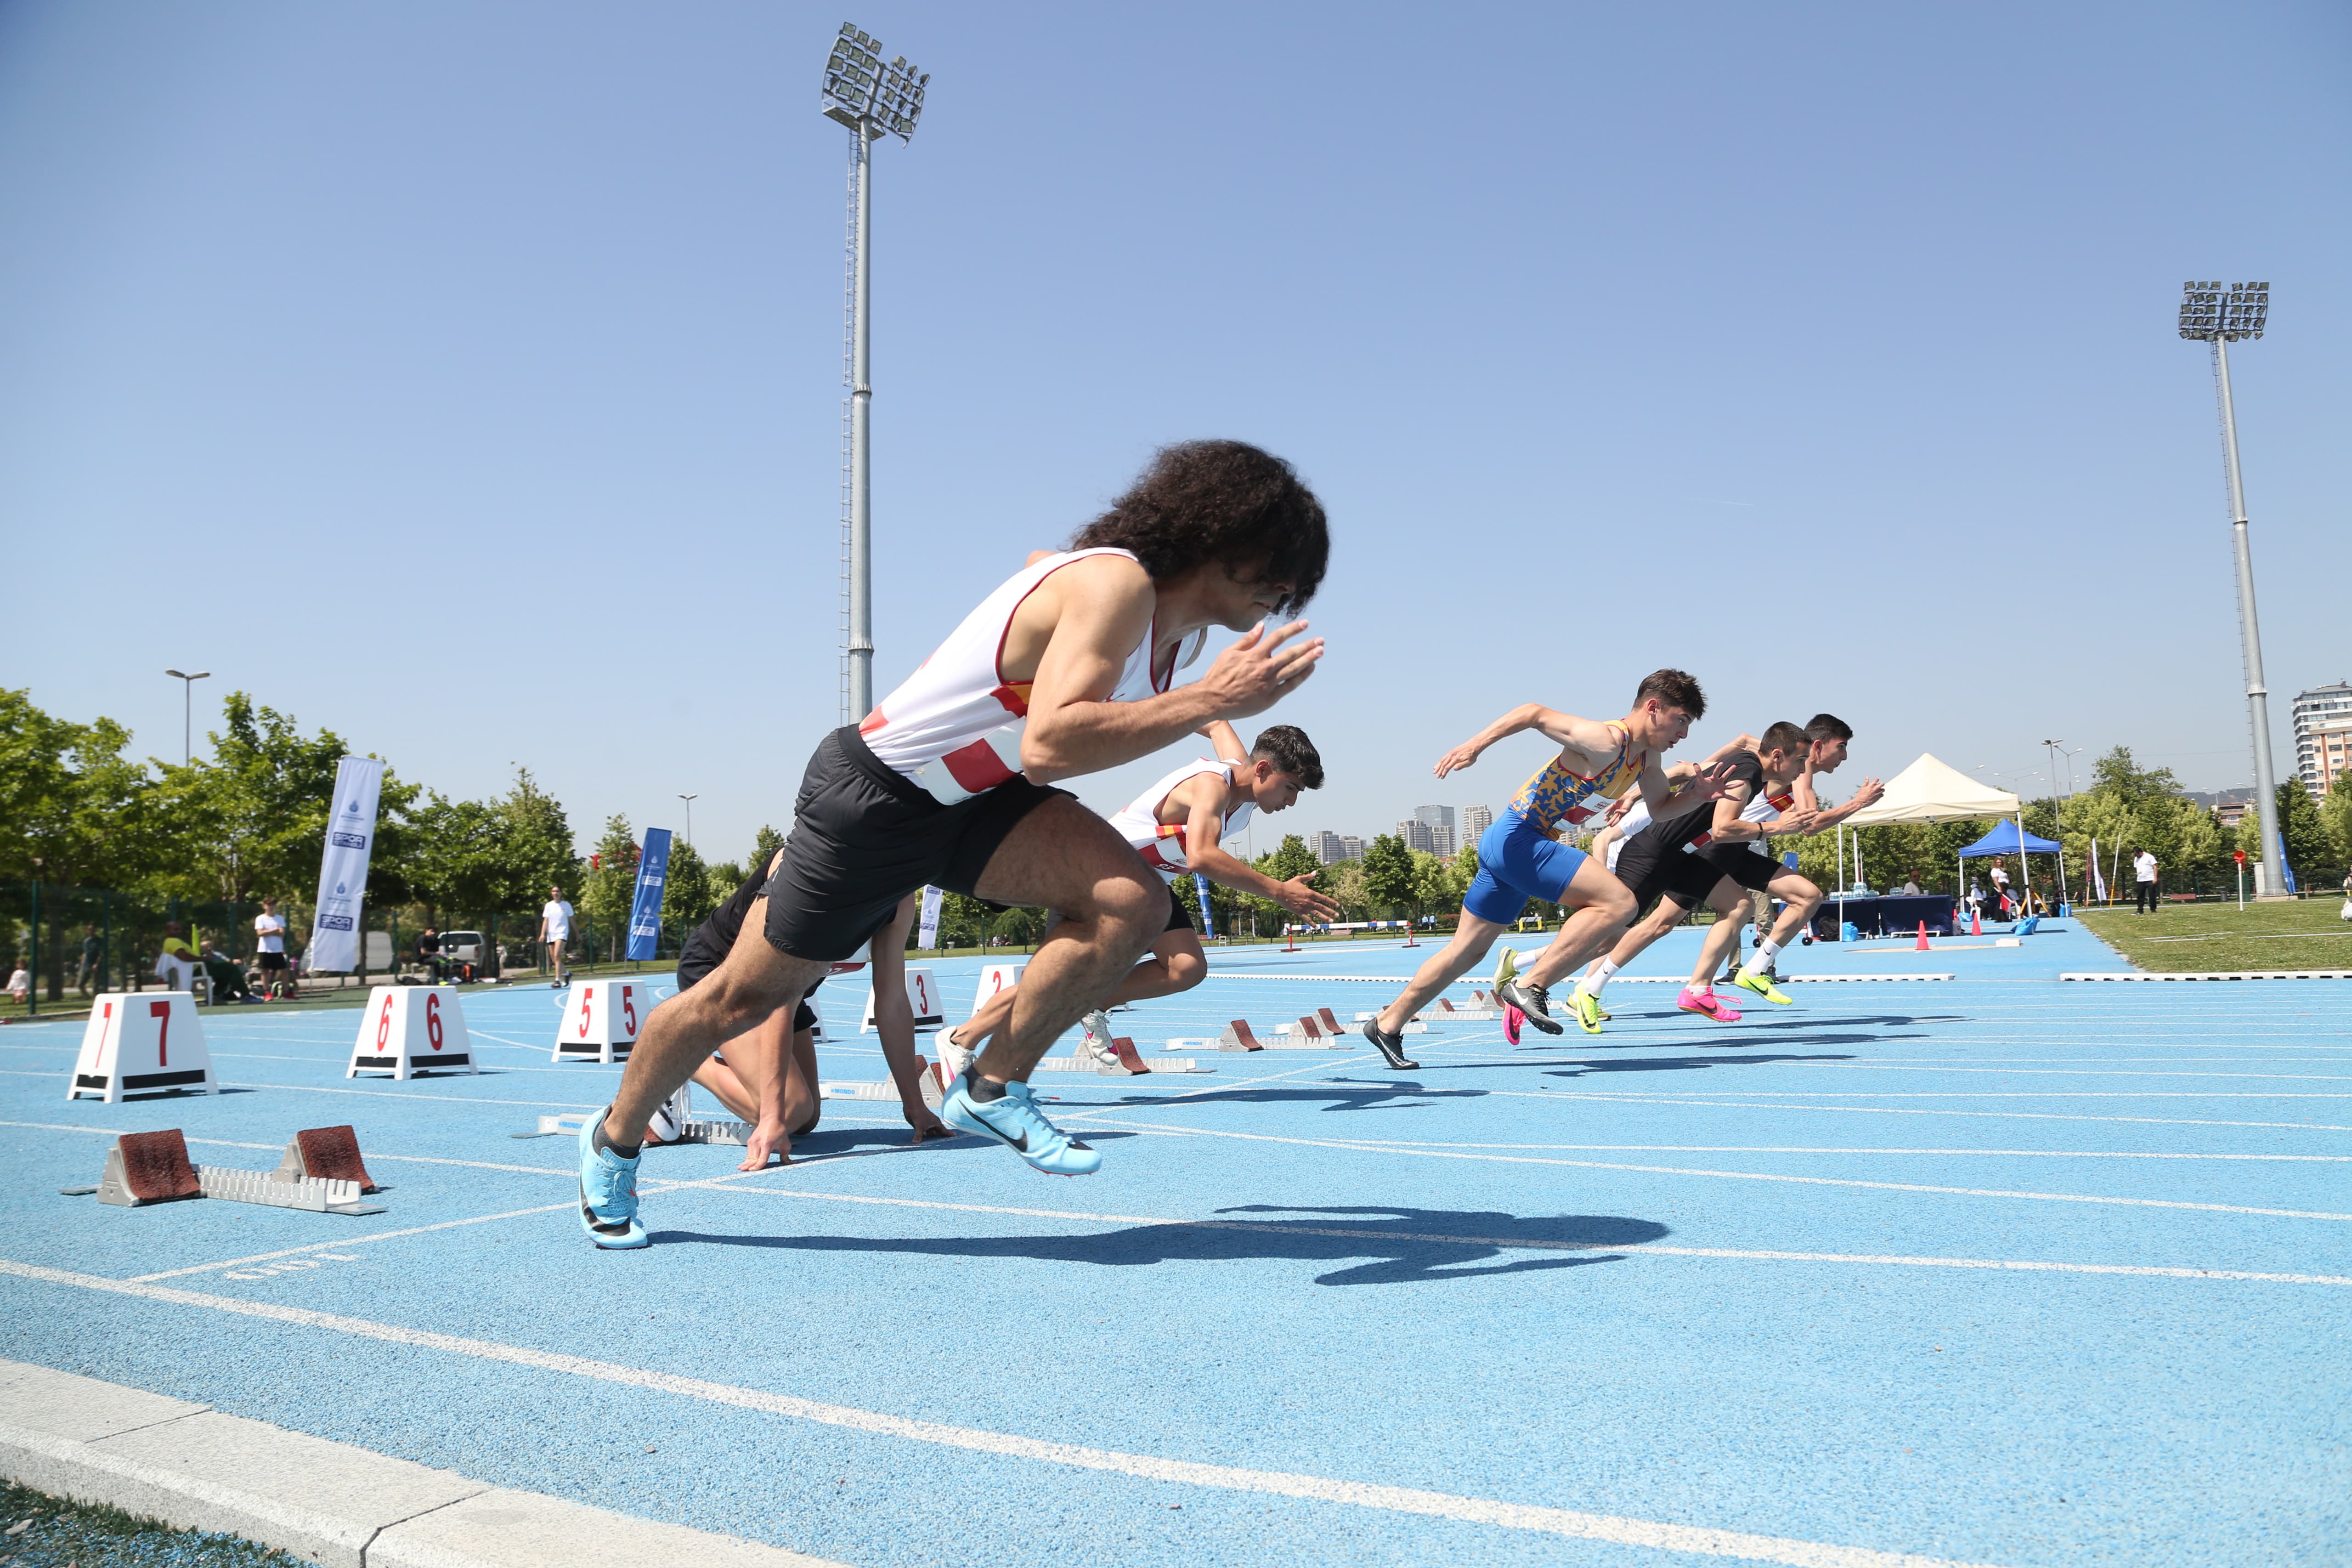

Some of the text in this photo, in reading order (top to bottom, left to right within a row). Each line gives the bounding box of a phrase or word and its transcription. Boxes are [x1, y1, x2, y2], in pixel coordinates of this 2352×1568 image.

[334, 833, 363, 843] SPOR
[322, 916, 350, 925] SPOR
[916, 974, 928, 1015] 3
[993, 971, 1001, 993] 2
[96, 1003, 112, 1069] 7
[150, 1001, 170, 1067] 7
[377, 994, 392, 1052] 6
[426, 993, 443, 1051] 6
[579, 988, 593, 1038] 5
[622, 986, 636, 1036] 5
